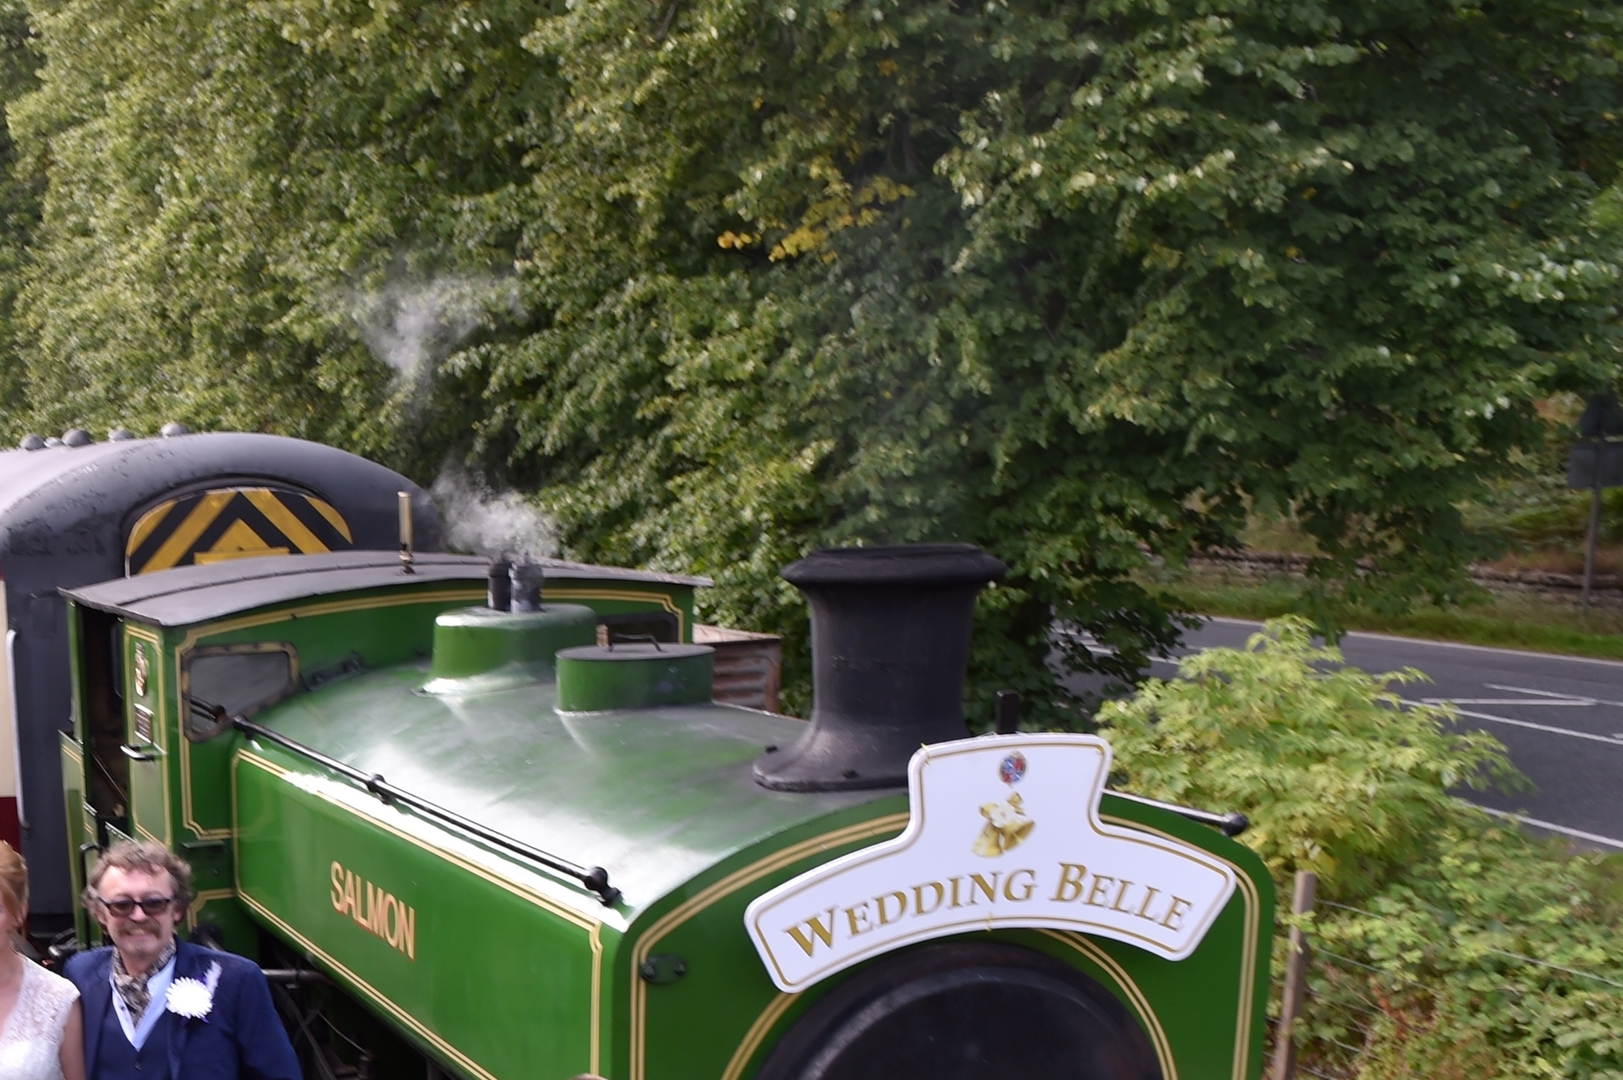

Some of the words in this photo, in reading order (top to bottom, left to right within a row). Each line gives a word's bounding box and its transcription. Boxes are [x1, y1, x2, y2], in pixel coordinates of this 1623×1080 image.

[331, 861, 416, 961] SALMON
[784, 868, 1037, 959] WEDDING
[1050, 862, 1193, 933] BELLE
